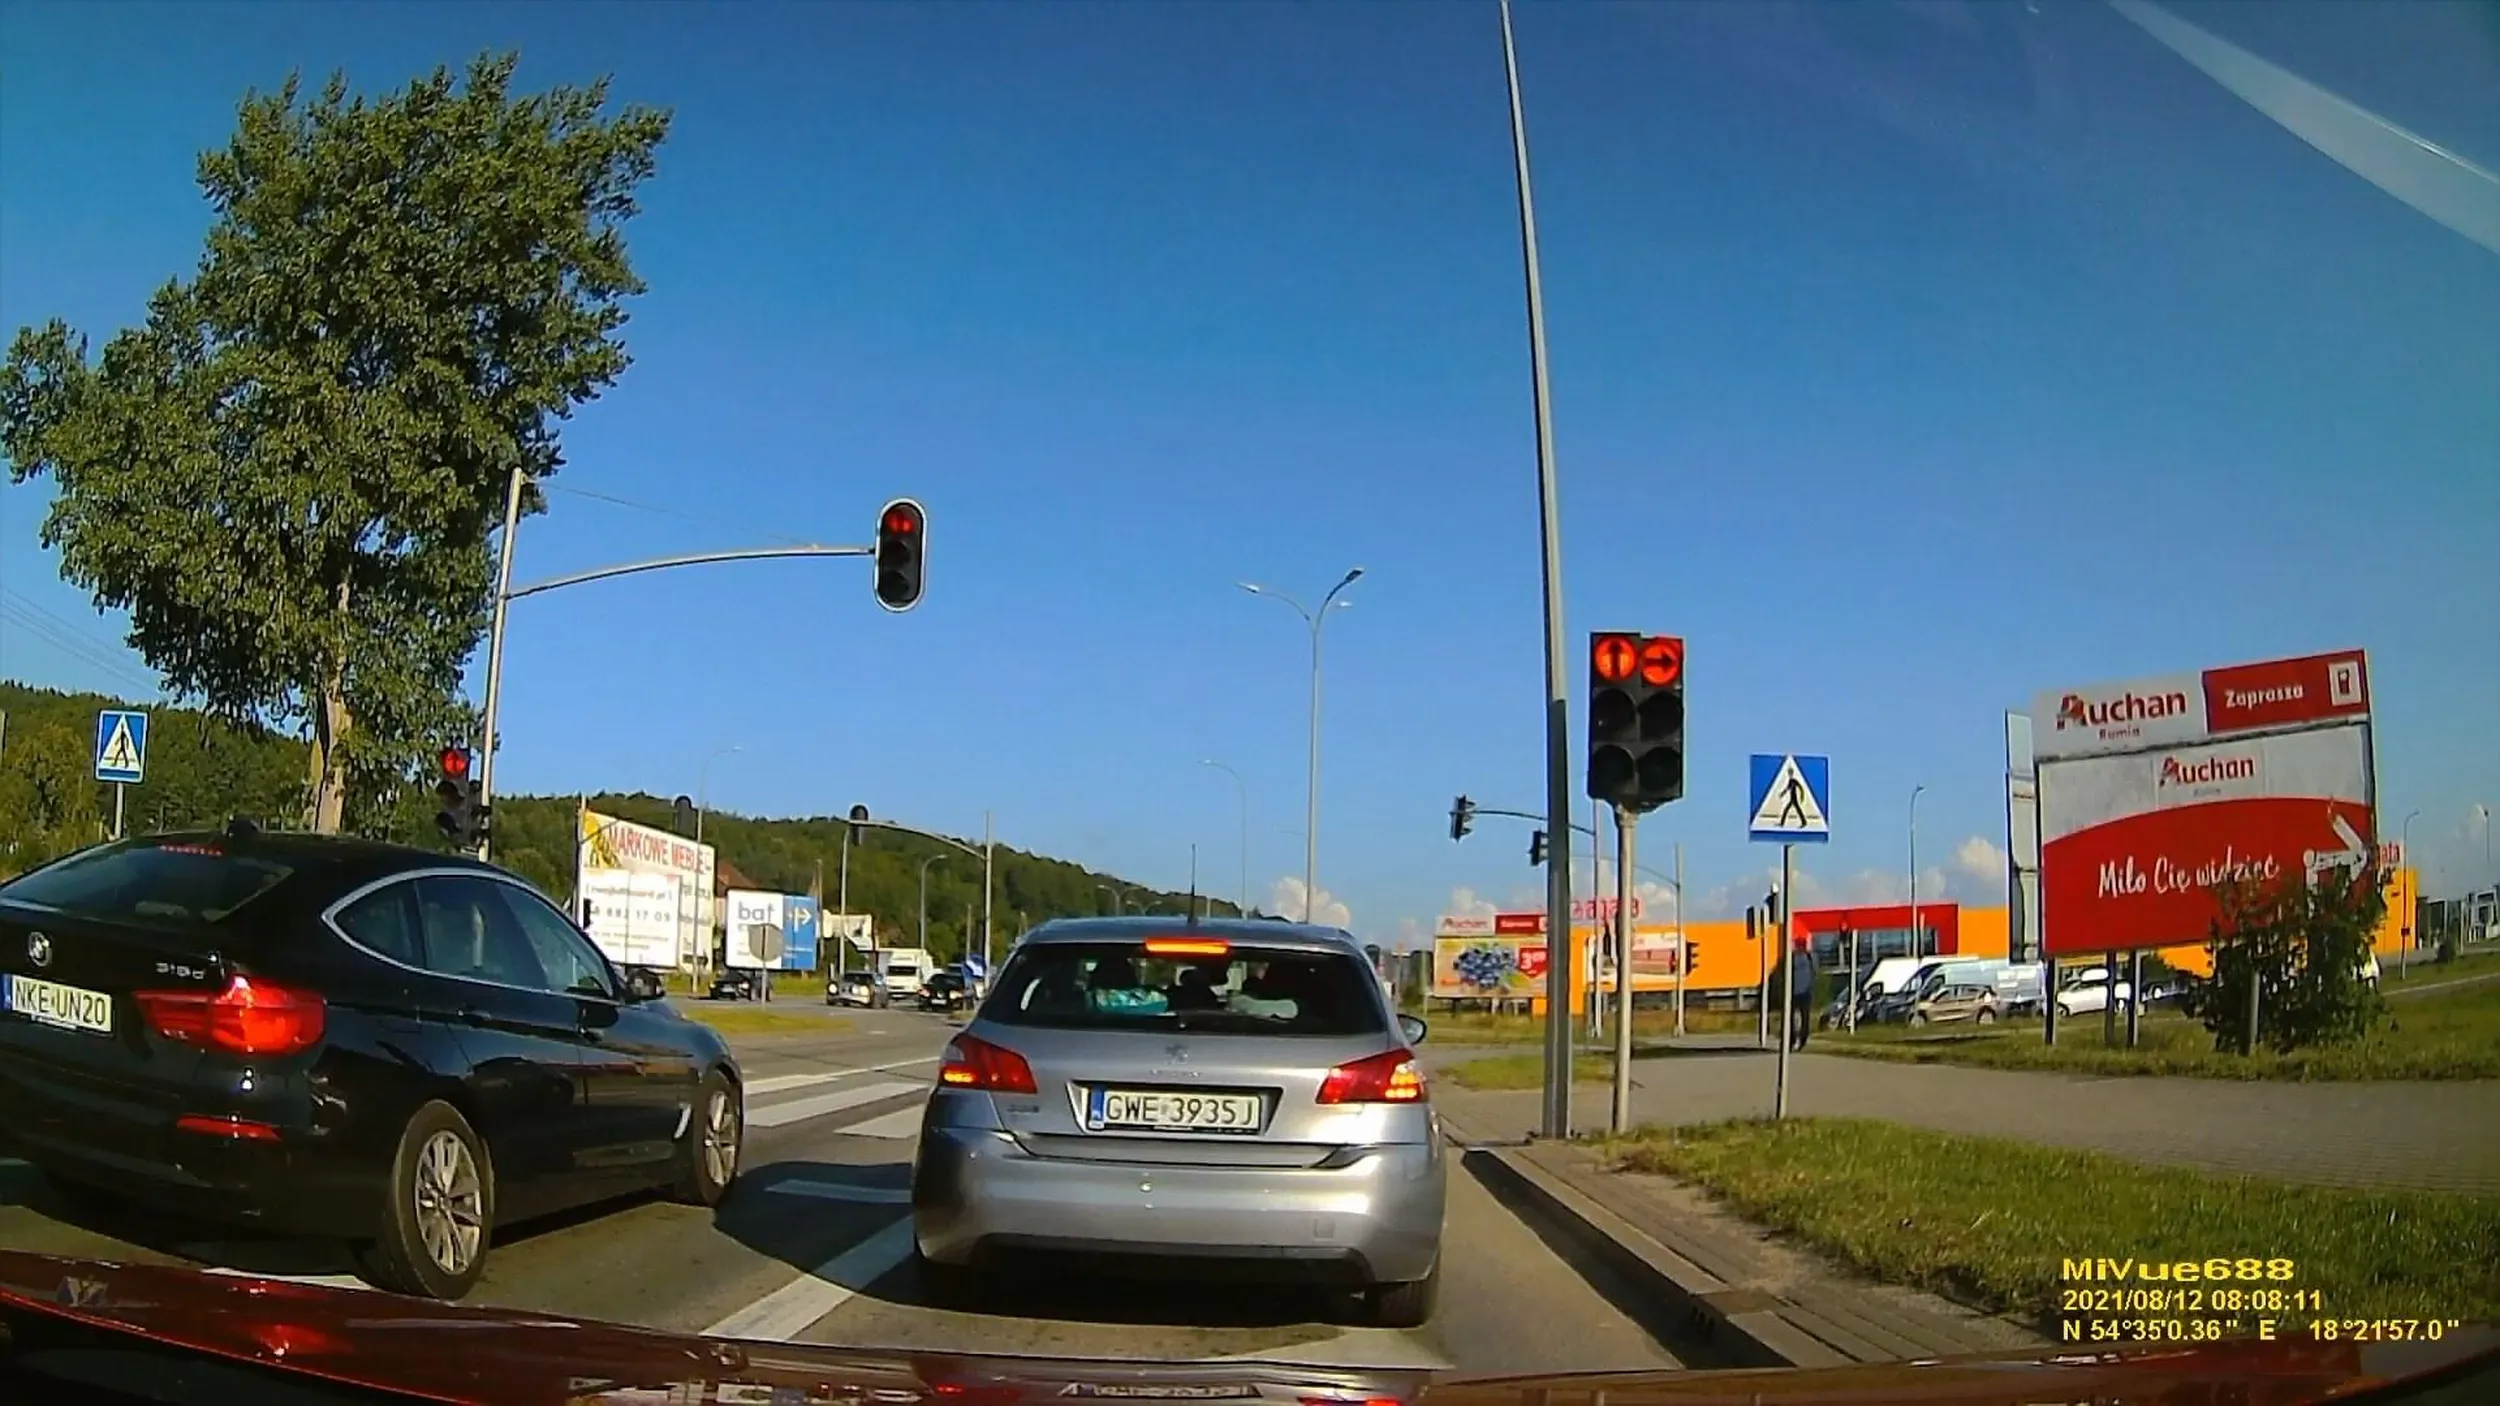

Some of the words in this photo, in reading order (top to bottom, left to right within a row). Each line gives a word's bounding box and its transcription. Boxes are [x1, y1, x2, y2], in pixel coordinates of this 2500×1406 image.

[2056, 690, 2186, 730] Auchan
[2224, 684, 2304, 710] Zaprasza
[2159, 756, 2255, 788] Auchan
[608, 821, 669, 867] MARKOWE
[16, 982, 50, 1012] NKE
[56, 991, 106, 1025] UN20
[1105, 1095, 1158, 1122] GWE
[1168, 1096, 1252, 1125] 3935J
